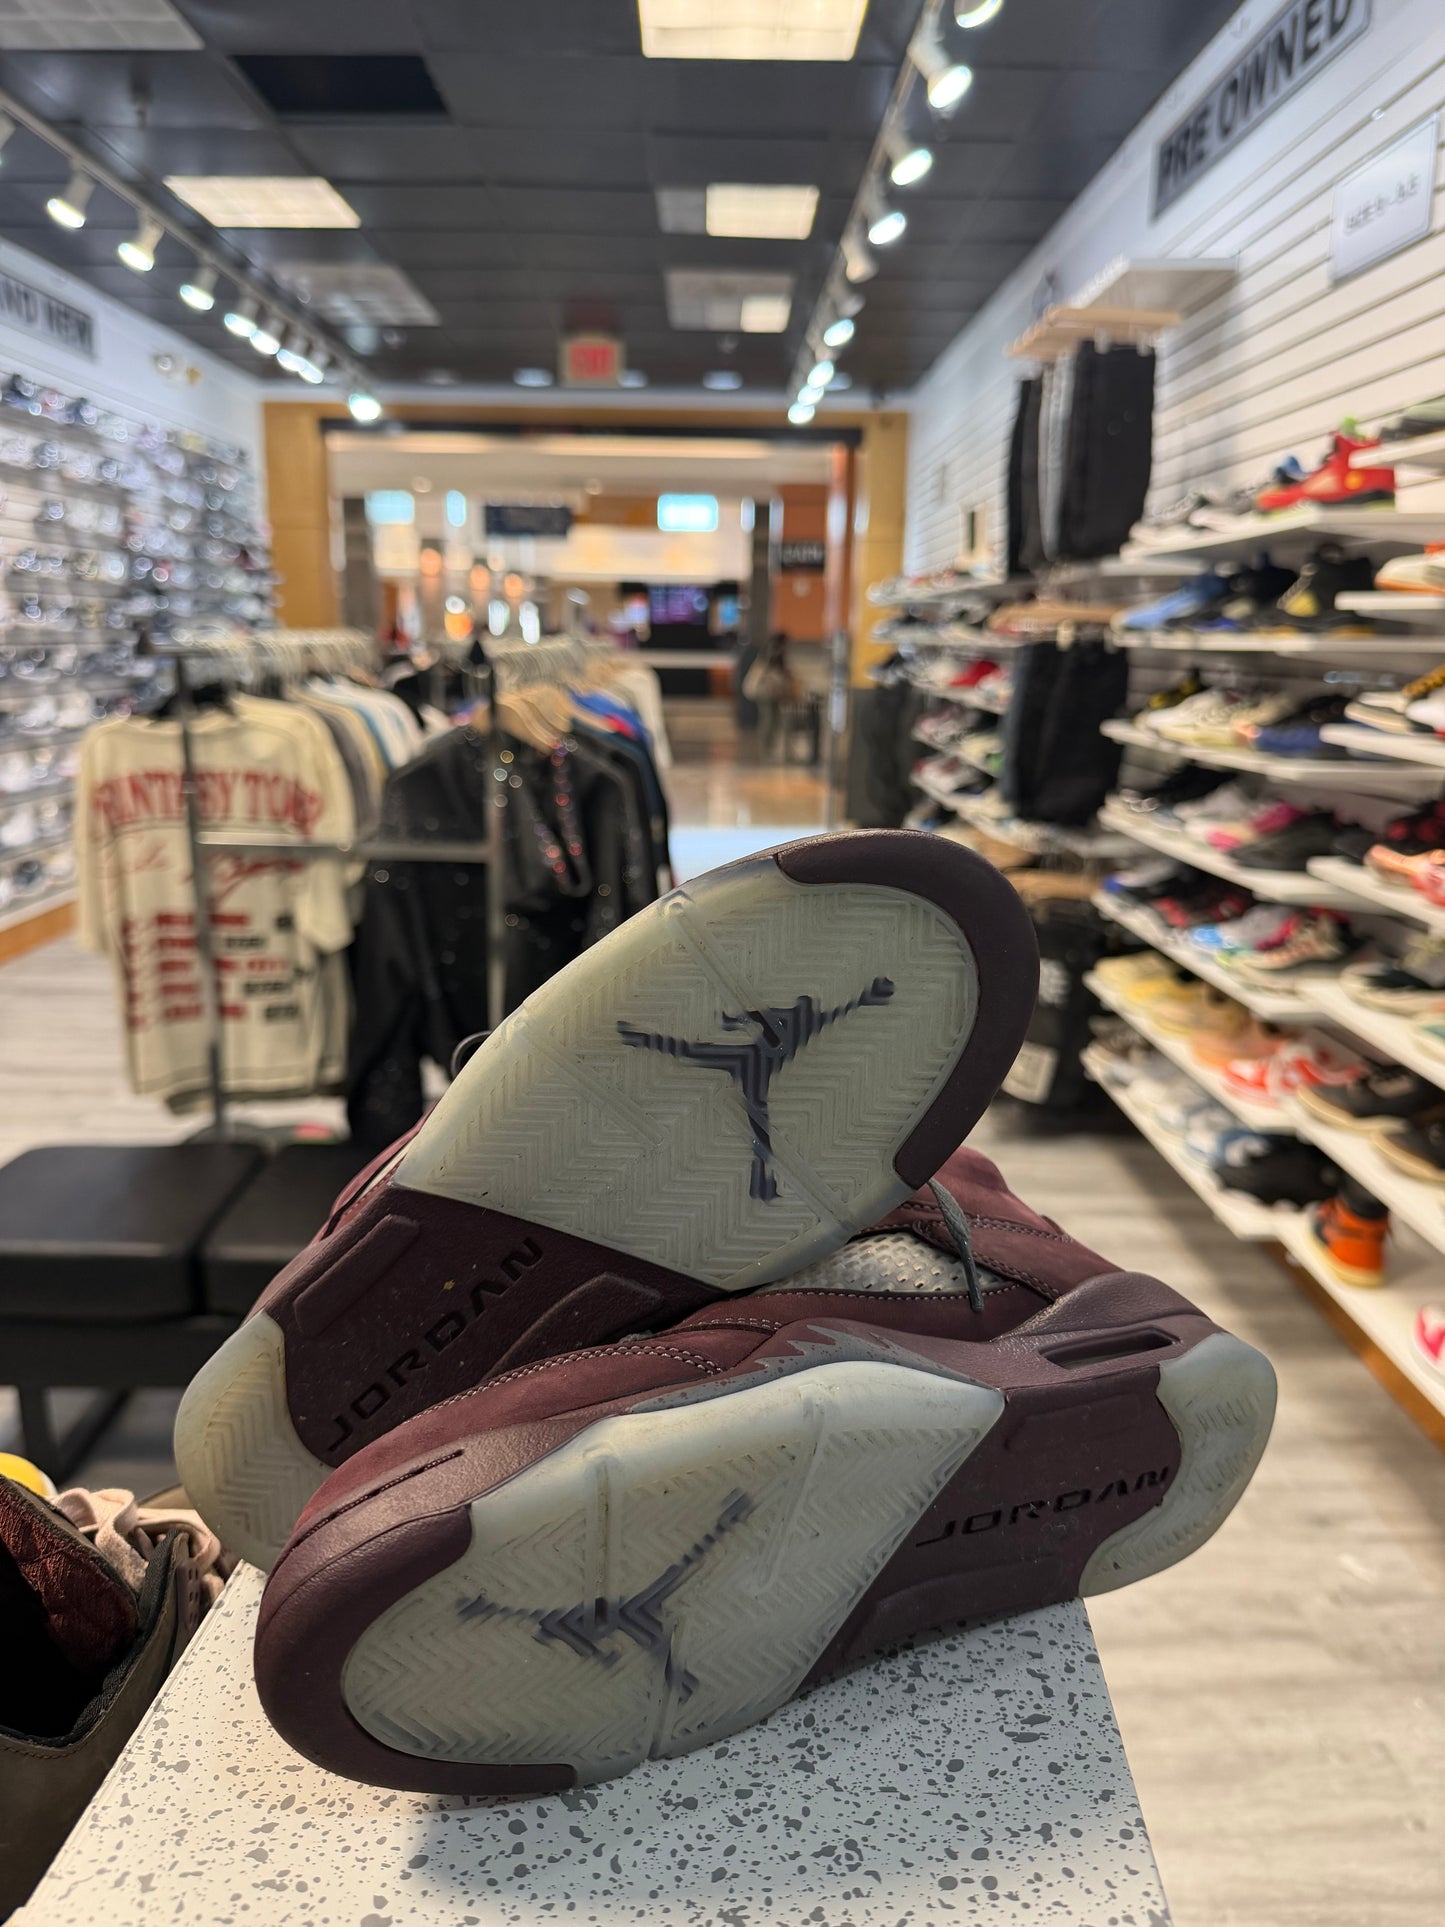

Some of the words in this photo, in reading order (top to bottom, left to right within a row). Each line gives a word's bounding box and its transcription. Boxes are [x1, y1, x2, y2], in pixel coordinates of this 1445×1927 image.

[1157, 103, 1211, 184] PRE
[1218, 0, 1351, 138] OWNED
[328, 1236, 544, 1452] JORDAN
[915, 1464, 1170, 1548] JORDAN
